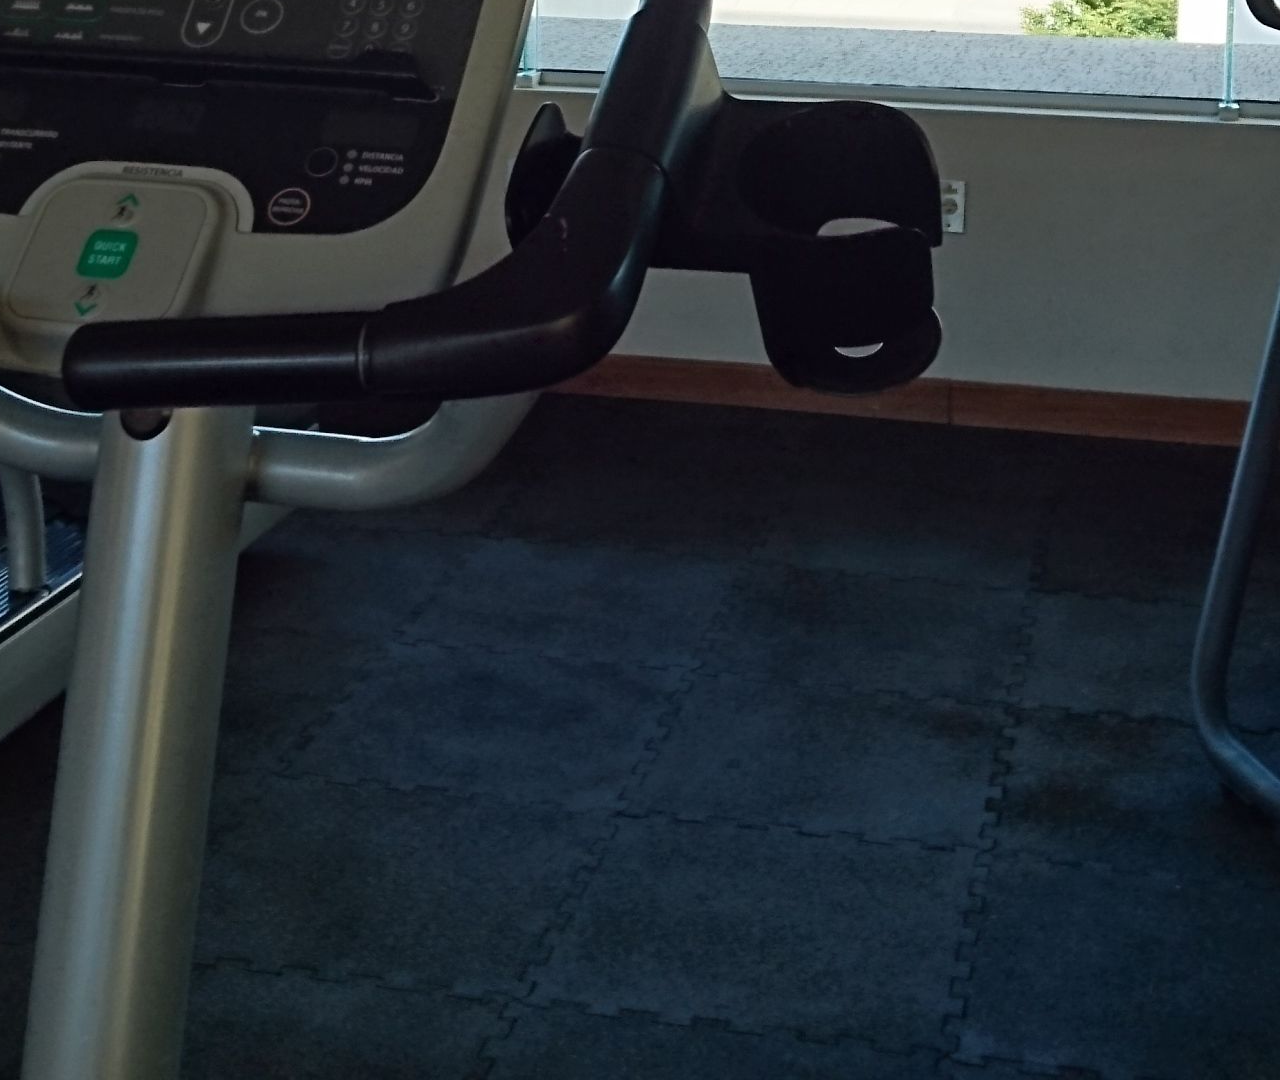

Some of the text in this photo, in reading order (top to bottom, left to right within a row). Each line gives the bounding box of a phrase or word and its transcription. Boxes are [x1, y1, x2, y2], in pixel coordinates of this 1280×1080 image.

[361, 151, 404, 162] DISTANCIA
[122, 167, 183, 177] RESISTENCIA
[358, 164, 404, 175] VELOCIDAD
[93, 240, 127, 252] QUICK
[87, 254, 122, 265] START
